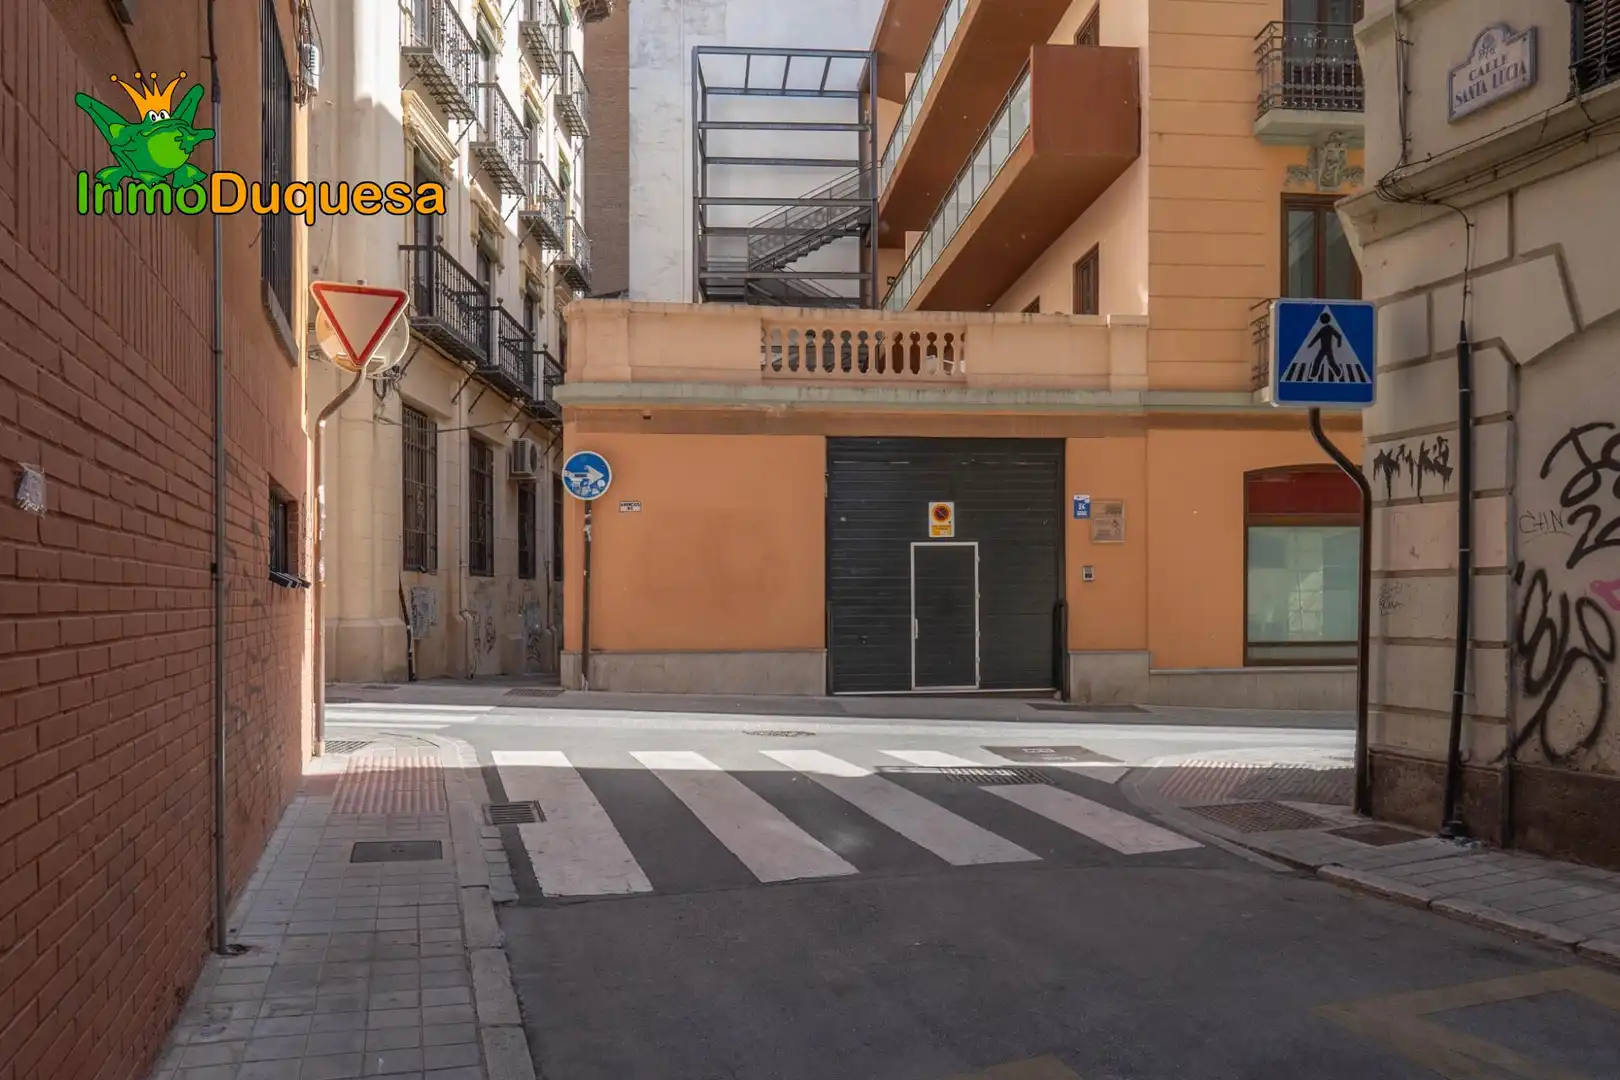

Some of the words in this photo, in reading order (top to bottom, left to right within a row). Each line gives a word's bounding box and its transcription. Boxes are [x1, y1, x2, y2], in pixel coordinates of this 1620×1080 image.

[1455, 80, 1488, 107] SANTA
[1492, 59, 1527, 89] LUCIA
[1468, 55, 1509, 81] CALLE
